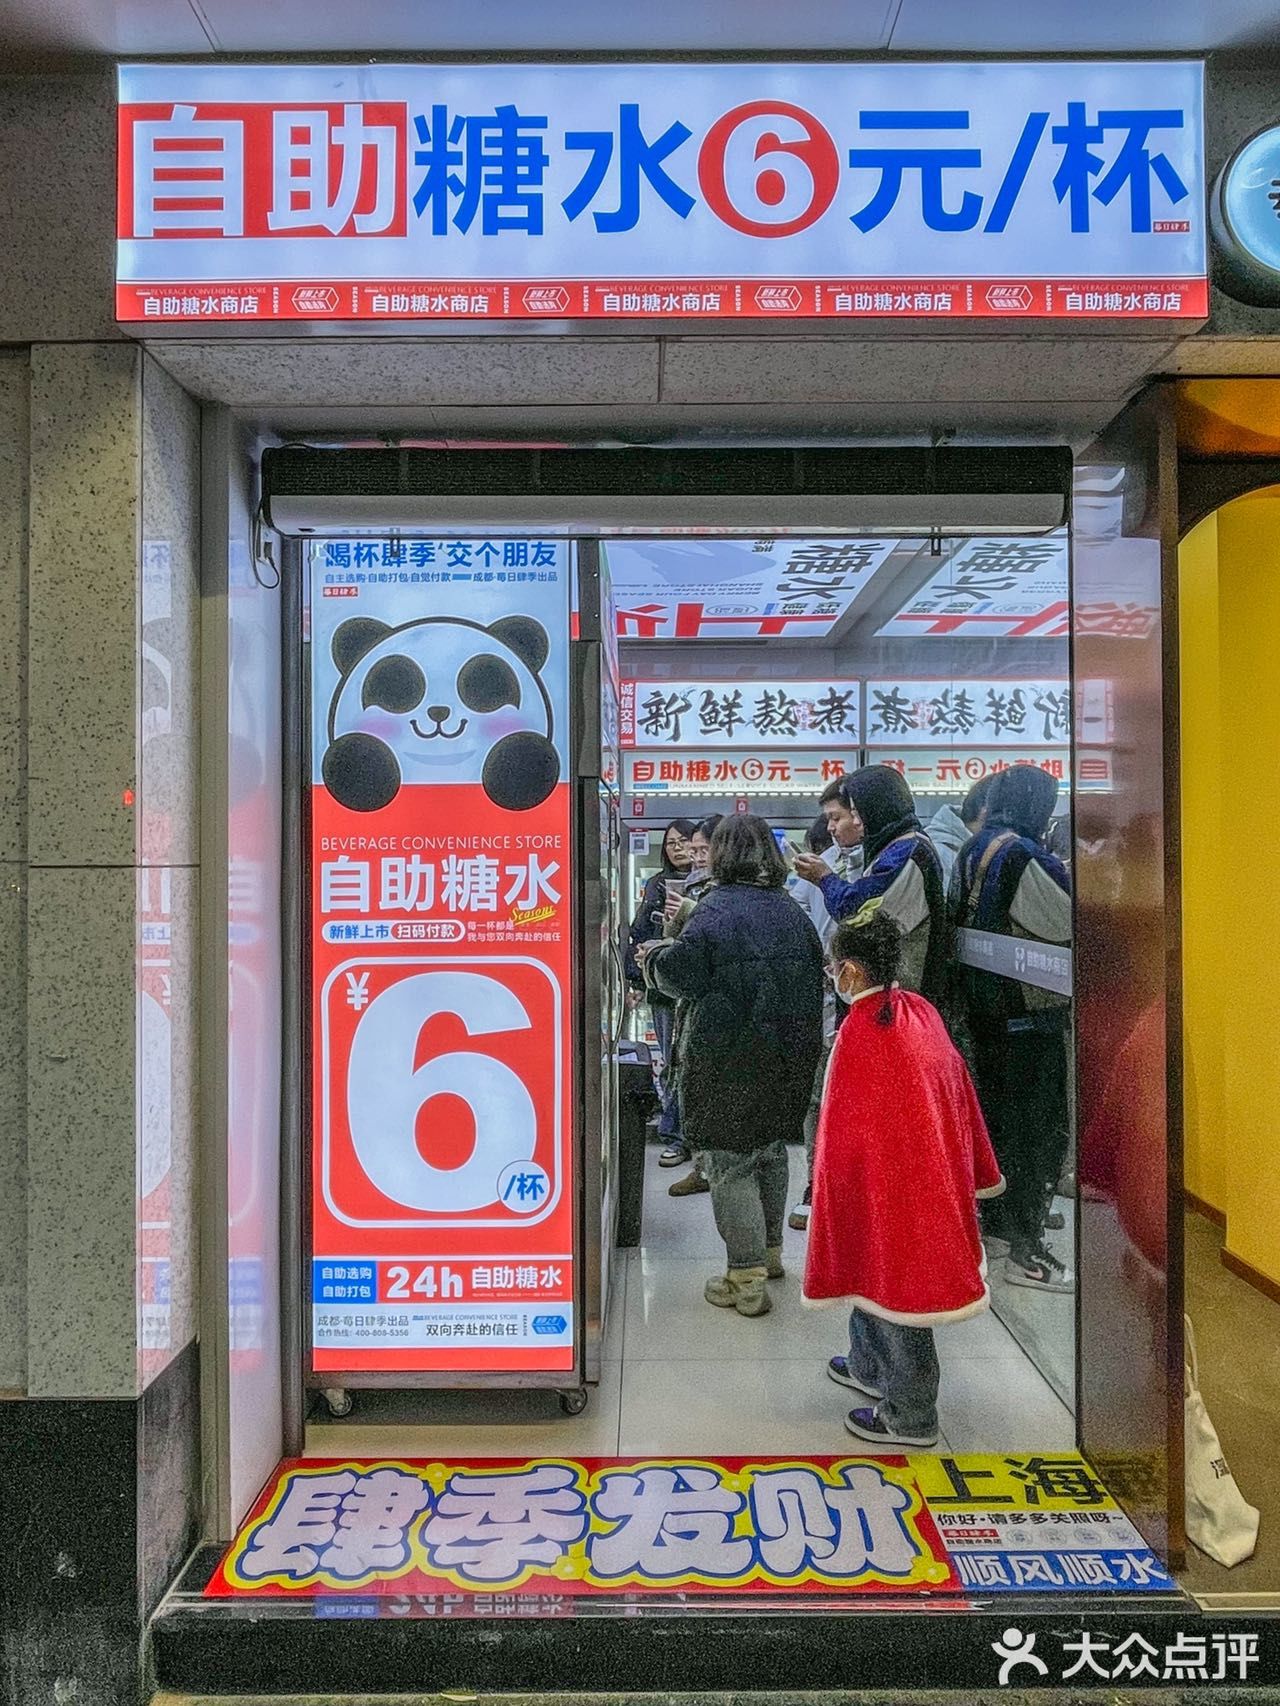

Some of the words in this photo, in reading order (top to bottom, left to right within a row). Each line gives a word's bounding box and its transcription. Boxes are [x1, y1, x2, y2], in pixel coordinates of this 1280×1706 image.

[144, 296, 259, 315] 自助糖水商店
[371, 294, 489, 313] 自助糖水商店
[602, 292, 721, 312] 自助糖水商店
[835, 292, 952, 311] 自助糖水商店
[1066, 292, 1181, 311] 自助糖水商店
[620, 682, 633, 735] 诚信交易
[637, 686, 859, 742] 新鲜熬煮
[321, 837, 397, 850] BEVERAGE
[401, 836, 510, 850] CONVENIENCE
[516, 835, 561, 848] STORE
[321, 854, 561, 912] 自助糖水
[512, 905, 554, 921] Seasons
[329, 925, 389, 939] 新鲜上市
[397, 924, 455, 938] 扫码付款
[503, 1172, 544, 1200] /杯
[322, 1267, 372, 1279] 自助选购
[386, 1266, 463, 1298] 24h
[472, 1265, 562, 1289] 自助糖水
[323, 1286, 371, 1297] 自助打包
[426, 1323, 518, 1336] 双向奔赴的信任
[926, 1458, 1108, 1504] 上海
[242, 1464, 918, 1580] 肆季发财
[953, 1554, 1168, 1585] 顺风顺水
